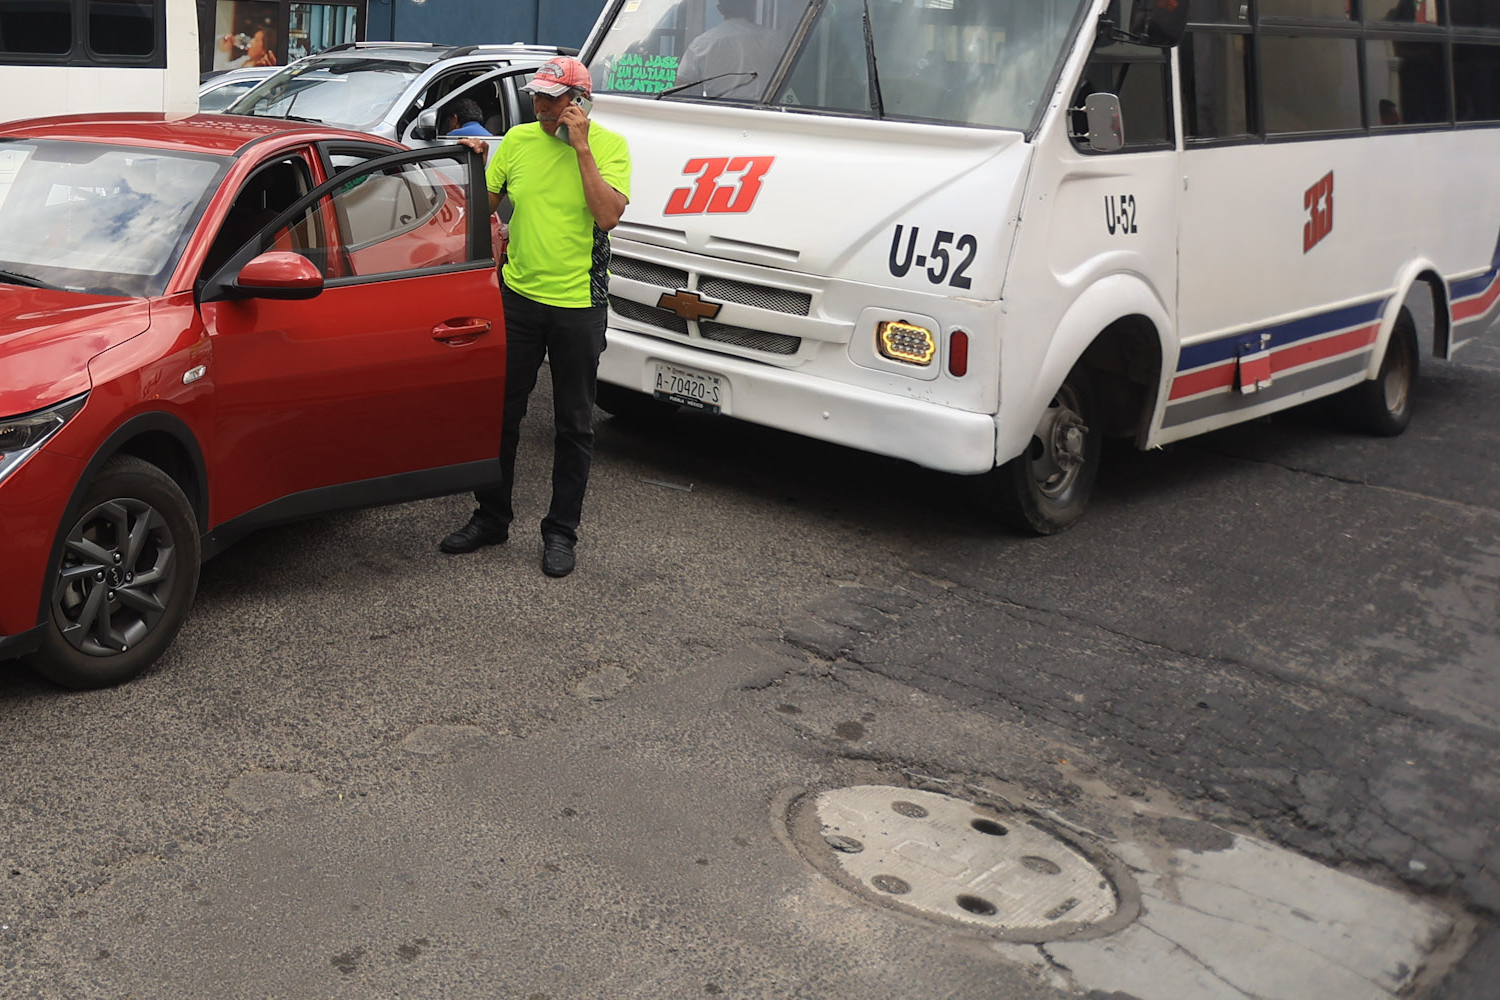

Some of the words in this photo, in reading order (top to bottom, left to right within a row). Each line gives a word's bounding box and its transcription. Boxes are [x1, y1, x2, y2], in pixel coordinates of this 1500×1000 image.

[663, 155, 777, 217] 33
[1104, 194, 1138, 235] U-52
[1303, 169, 1334, 255] 33
[888, 224, 978, 290] U-52
[656, 372, 720, 403] A-70420-S
